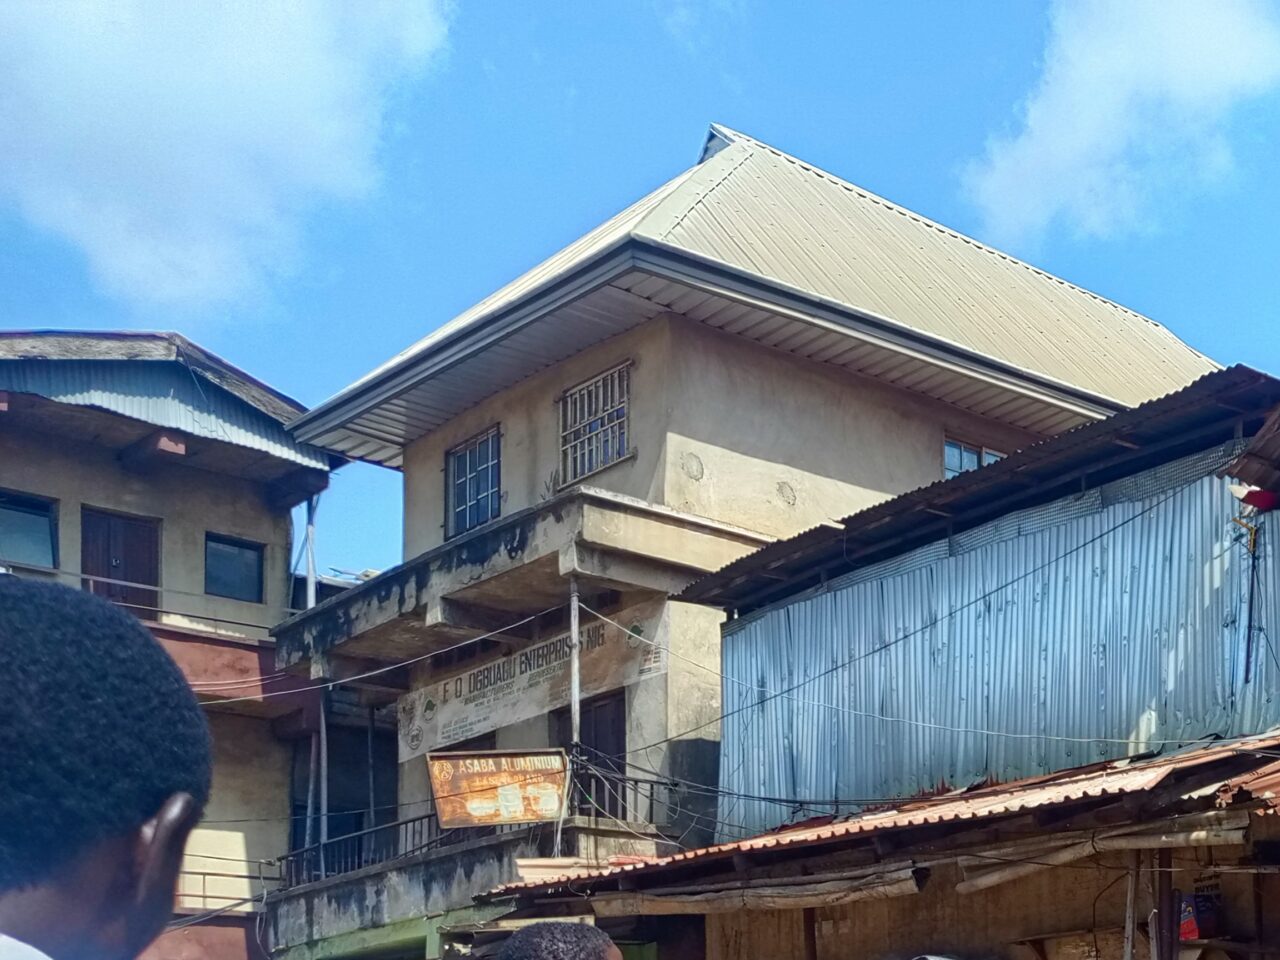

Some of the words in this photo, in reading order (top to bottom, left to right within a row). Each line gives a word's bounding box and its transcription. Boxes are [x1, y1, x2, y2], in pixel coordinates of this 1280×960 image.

[519, 630, 584, 676] ENTERPRISS
[459, 758, 497, 774] ASABA
[501, 755, 561, 772] ALUMINIUM
